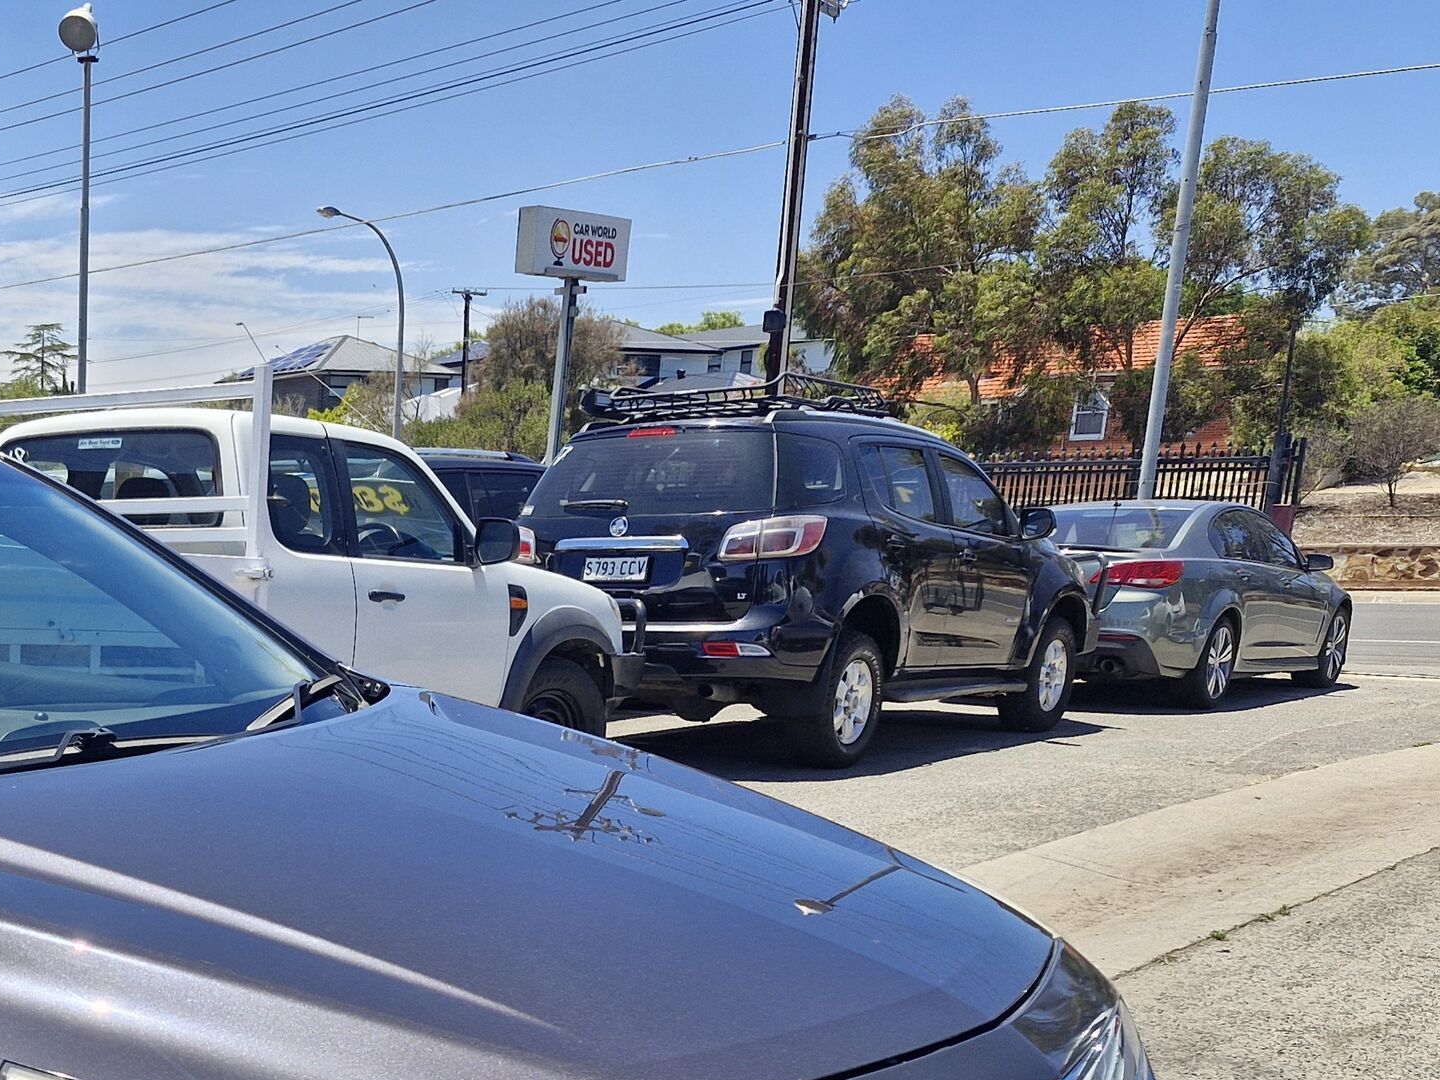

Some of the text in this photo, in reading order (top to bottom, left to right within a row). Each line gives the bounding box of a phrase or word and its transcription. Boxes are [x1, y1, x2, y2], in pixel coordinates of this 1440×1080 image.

[573, 222, 617, 239] CAR WORLD
[571, 237, 615, 268] USED
